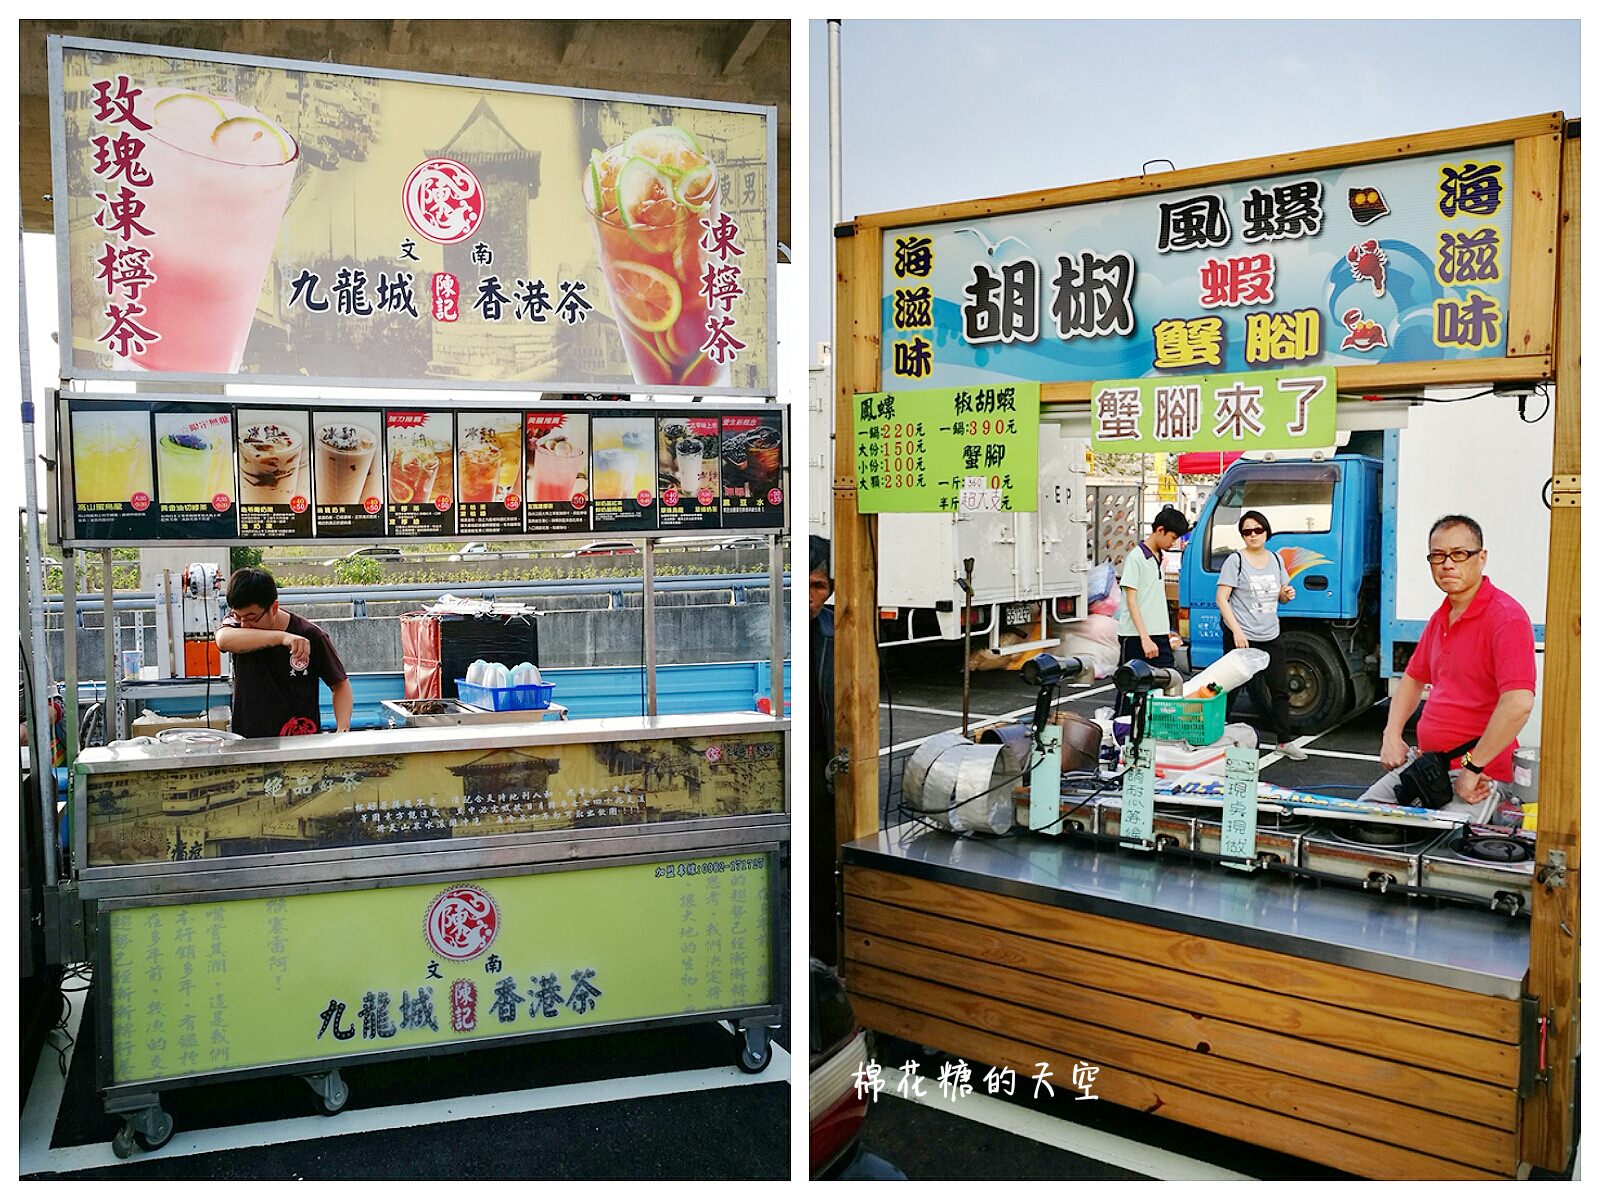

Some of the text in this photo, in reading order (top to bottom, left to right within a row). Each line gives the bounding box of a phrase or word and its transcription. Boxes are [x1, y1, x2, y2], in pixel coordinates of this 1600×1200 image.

[91, 75, 161, 358] 玫瑰凍檸茶
[1157, 181, 1322, 252] 風螺
[400, 238, 493, 266] 文 南
[1200, 253, 1274, 306] 蝦
[1437, 163, 1503, 347] 海滋味
[287, 268, 594, 325] 九龍城 陳記 香港茶
[699, 212, 747, 364] 凍檸茶
[895, 236, 933, 378] 海滋味
[964, 251, 1134, 342] 胡椒
[1153, 311, 1320, 369] 蟹腳
[954, 387, 1017, 416] 椒胡蝦
[1097, 378, 1325, 440] 蟹腳來了
[962, 444, 1006, 470] 蟹腳
[425, 953, 502, 979] 文 南
[316, 968, 603, 1042] 九龍城 陳記 香港茶
